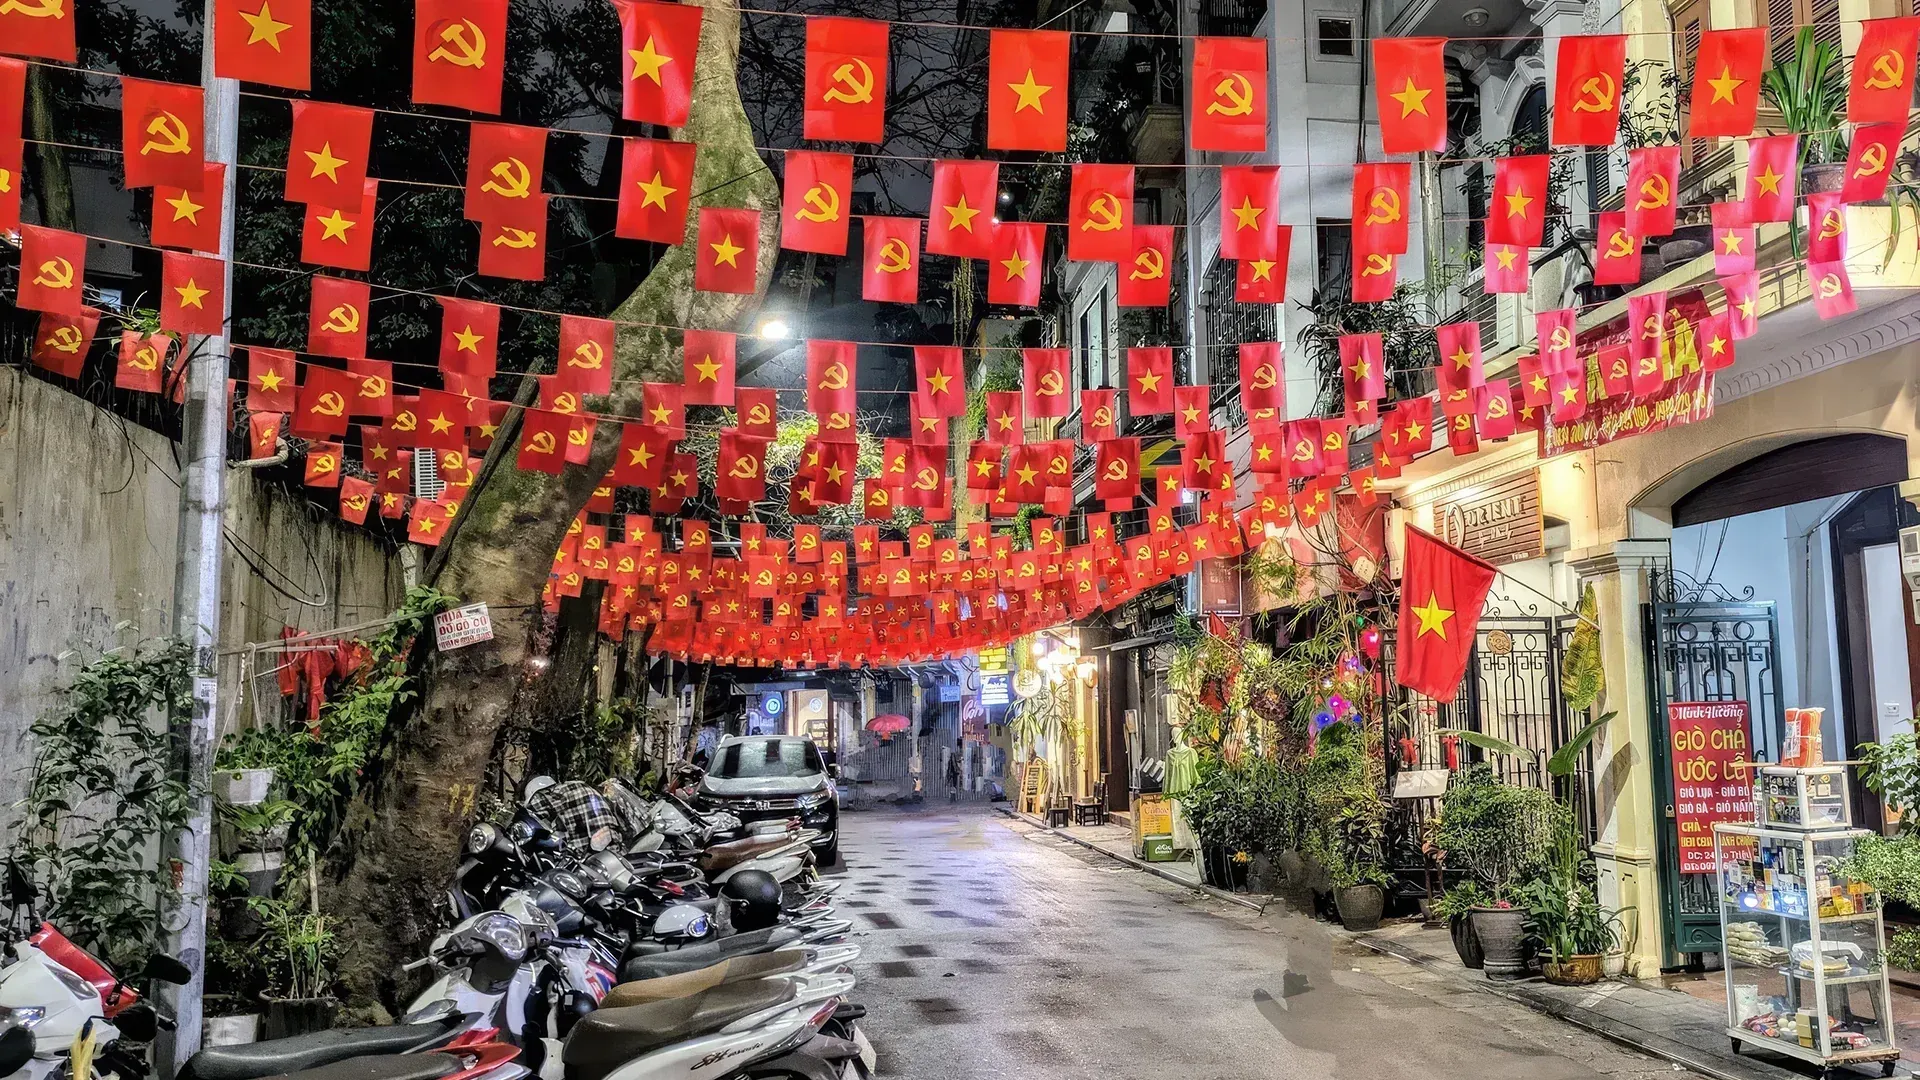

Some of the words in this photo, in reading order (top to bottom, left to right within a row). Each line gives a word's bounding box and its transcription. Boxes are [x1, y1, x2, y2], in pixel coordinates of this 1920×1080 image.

[1674, 725, 1706, 751] GIÒ
[1710, 723, 1746, 750] CHẢ
[1680, 785, 1695, 798] GIÒ
[1679, 801, 1694, 814] GIÒ
